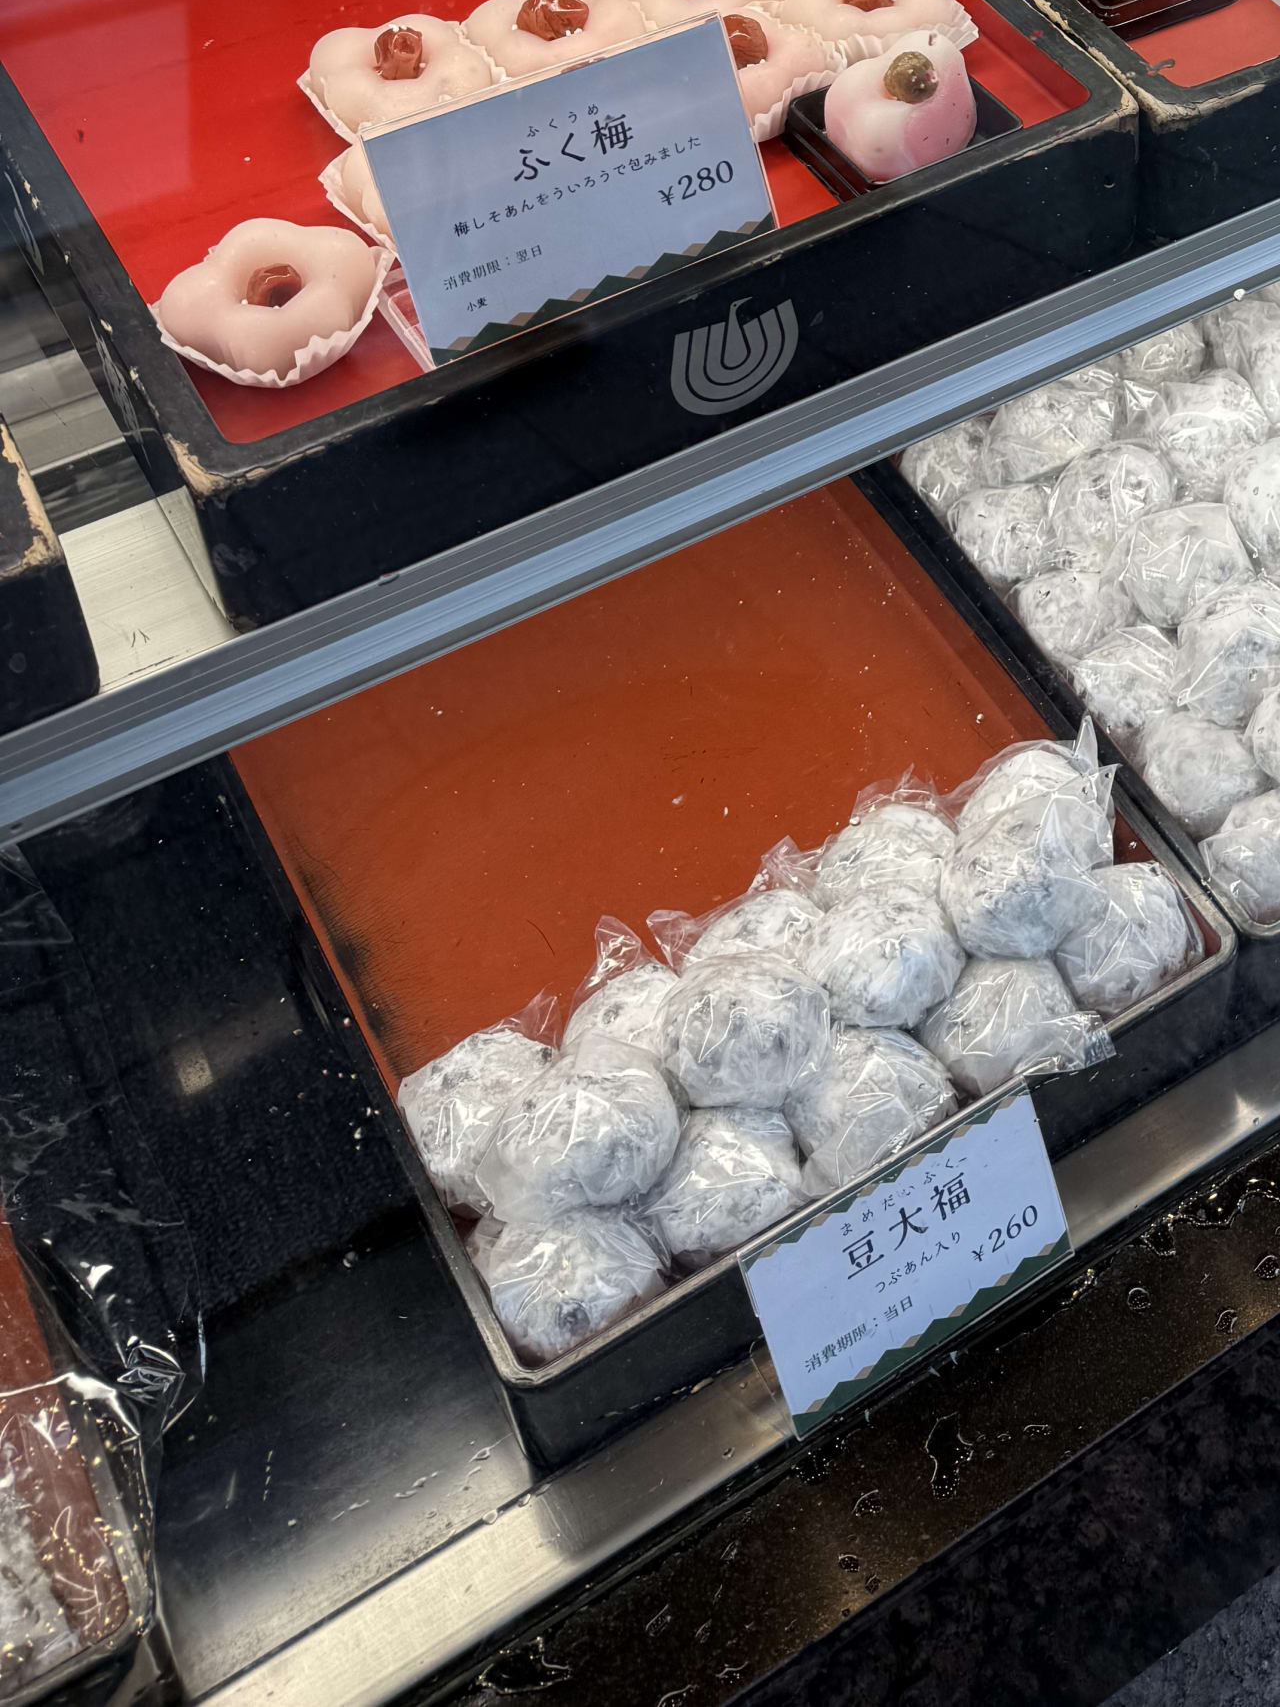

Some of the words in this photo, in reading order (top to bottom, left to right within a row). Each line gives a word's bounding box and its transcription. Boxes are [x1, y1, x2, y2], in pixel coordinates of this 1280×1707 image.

[513, 113, 634, 183] ふく梅
[526, 103, 600, 139] ふくうめ
[453, 135, 702, 238] 梅しそあんをういろうで包みました
[657, 160, 735, 207] ¥280
[443, 245, 543, 291] 消費期限：翌日
[466, 295, 489, 313] 小麦
[842, 1172, 971, 1279] 豆大福
[972, 1205, 1039, 1263] ¥260
[875, 1231, 961, 1293] つぶあん入り
[804, 1295, 914, 1374] 消費期限：当日
